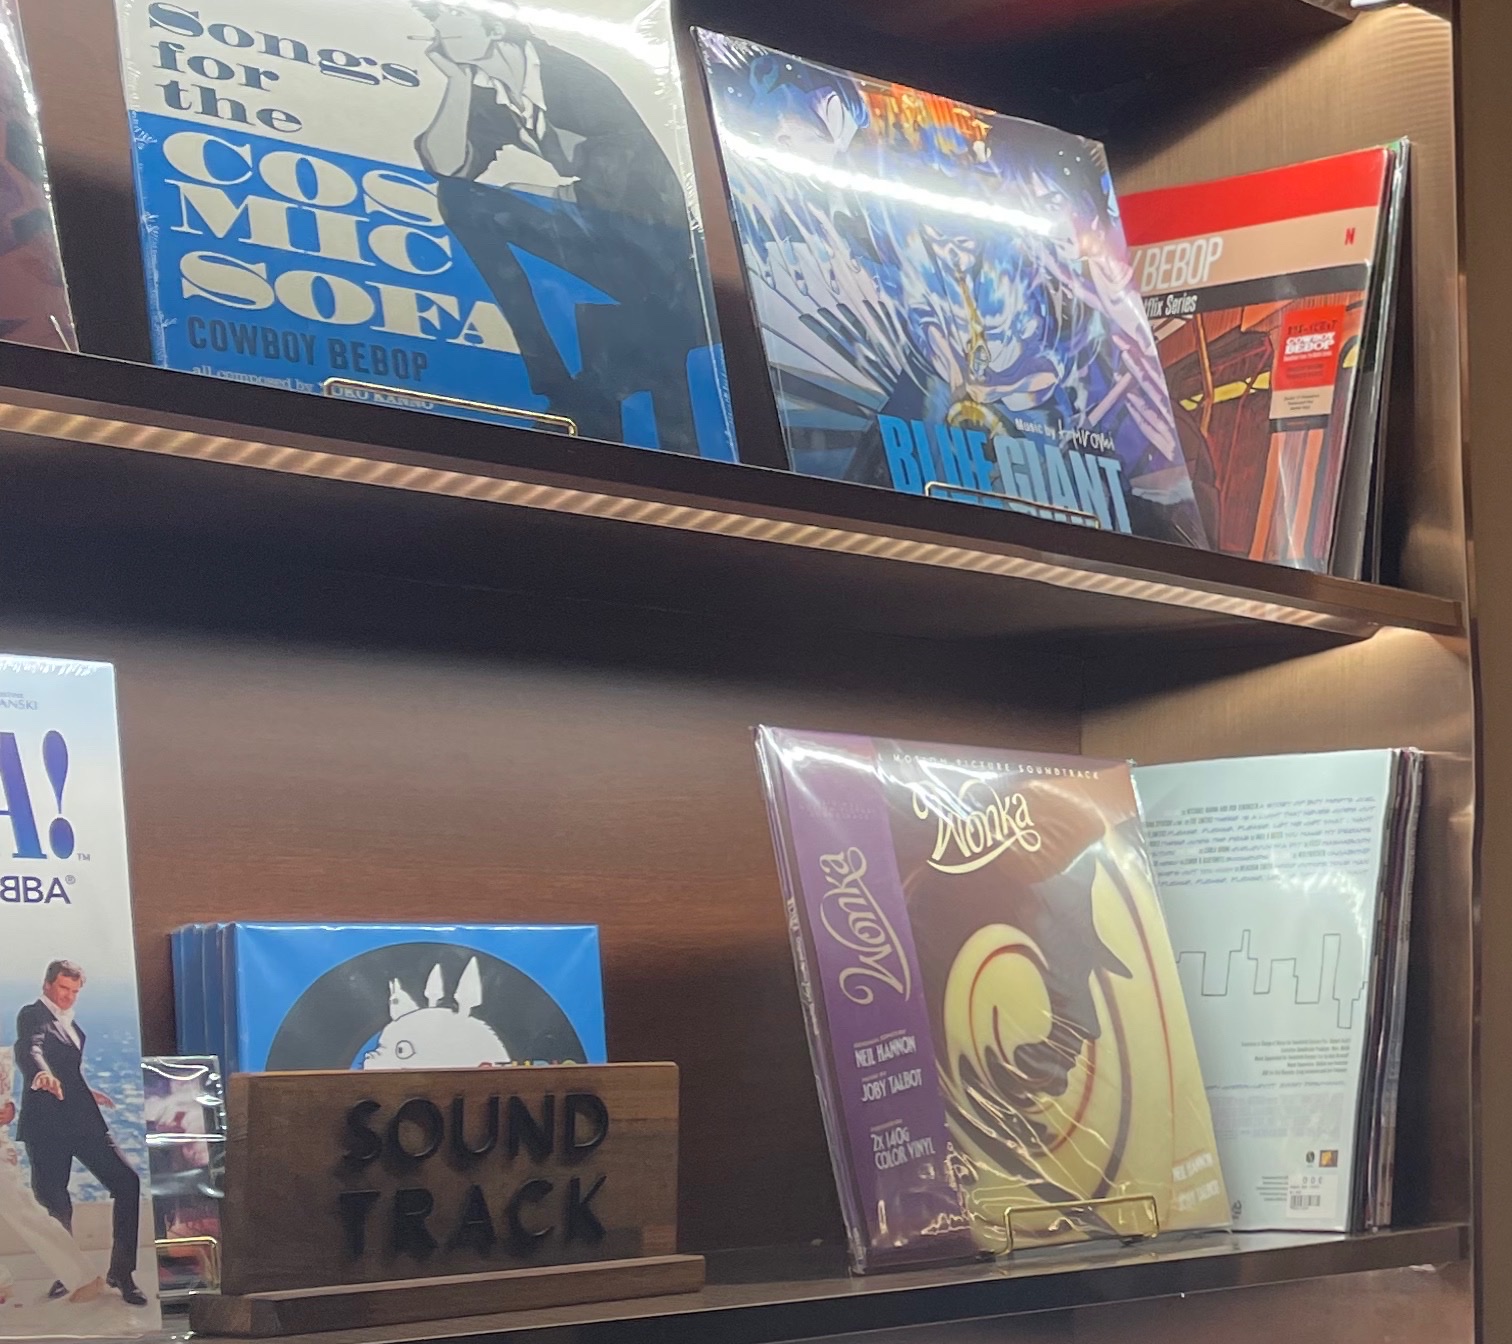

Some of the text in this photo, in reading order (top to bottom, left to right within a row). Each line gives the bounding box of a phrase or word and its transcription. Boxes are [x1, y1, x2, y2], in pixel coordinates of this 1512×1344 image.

[148, 2, 421, 88] Songs
[152, 40, 280, 93] for
[161, 79, 303, 135] the
[163, 131, 441, 227] COS
[164, 179, 454, 276] MIC
[1141, 237, 1223, 292] BEBOP
[180, 250, 520, 355] SOFA
[1142, 294, 1198, 317] tflix Series
[187, 316, 431, 383] COWBOY BEBOP
[1285, 341, 1335, 355] BEBOP
[1015, 418, 1043, 434] Music
[1045, 426, 1056, 440] by
[877, 414, 1132, 534] BLUE GIANT
[0, 698, 38, 711] ANSKI
[0, 730, 75, 860] A!
[956, 758, 1011, 772] PICTURE
[1019, 764, 1099, 780] SOUNDTRACK
[912, 778, 1041, 875] Wonka
[819, 846, 911, 1007] Wonka
[855, 1048, 876, 1068] NEIL
[876, 1036, 917, 1062] HANNON
[861, 1078, 886, 1102] JOBY
[888, 1068, 922, 1094] TALBOT
[340, 1089, 610, 1167] SOUND
[875, 1137, 936, 1170] COLOR VINYL
[337, 1173, 610, 1261] TRACK
